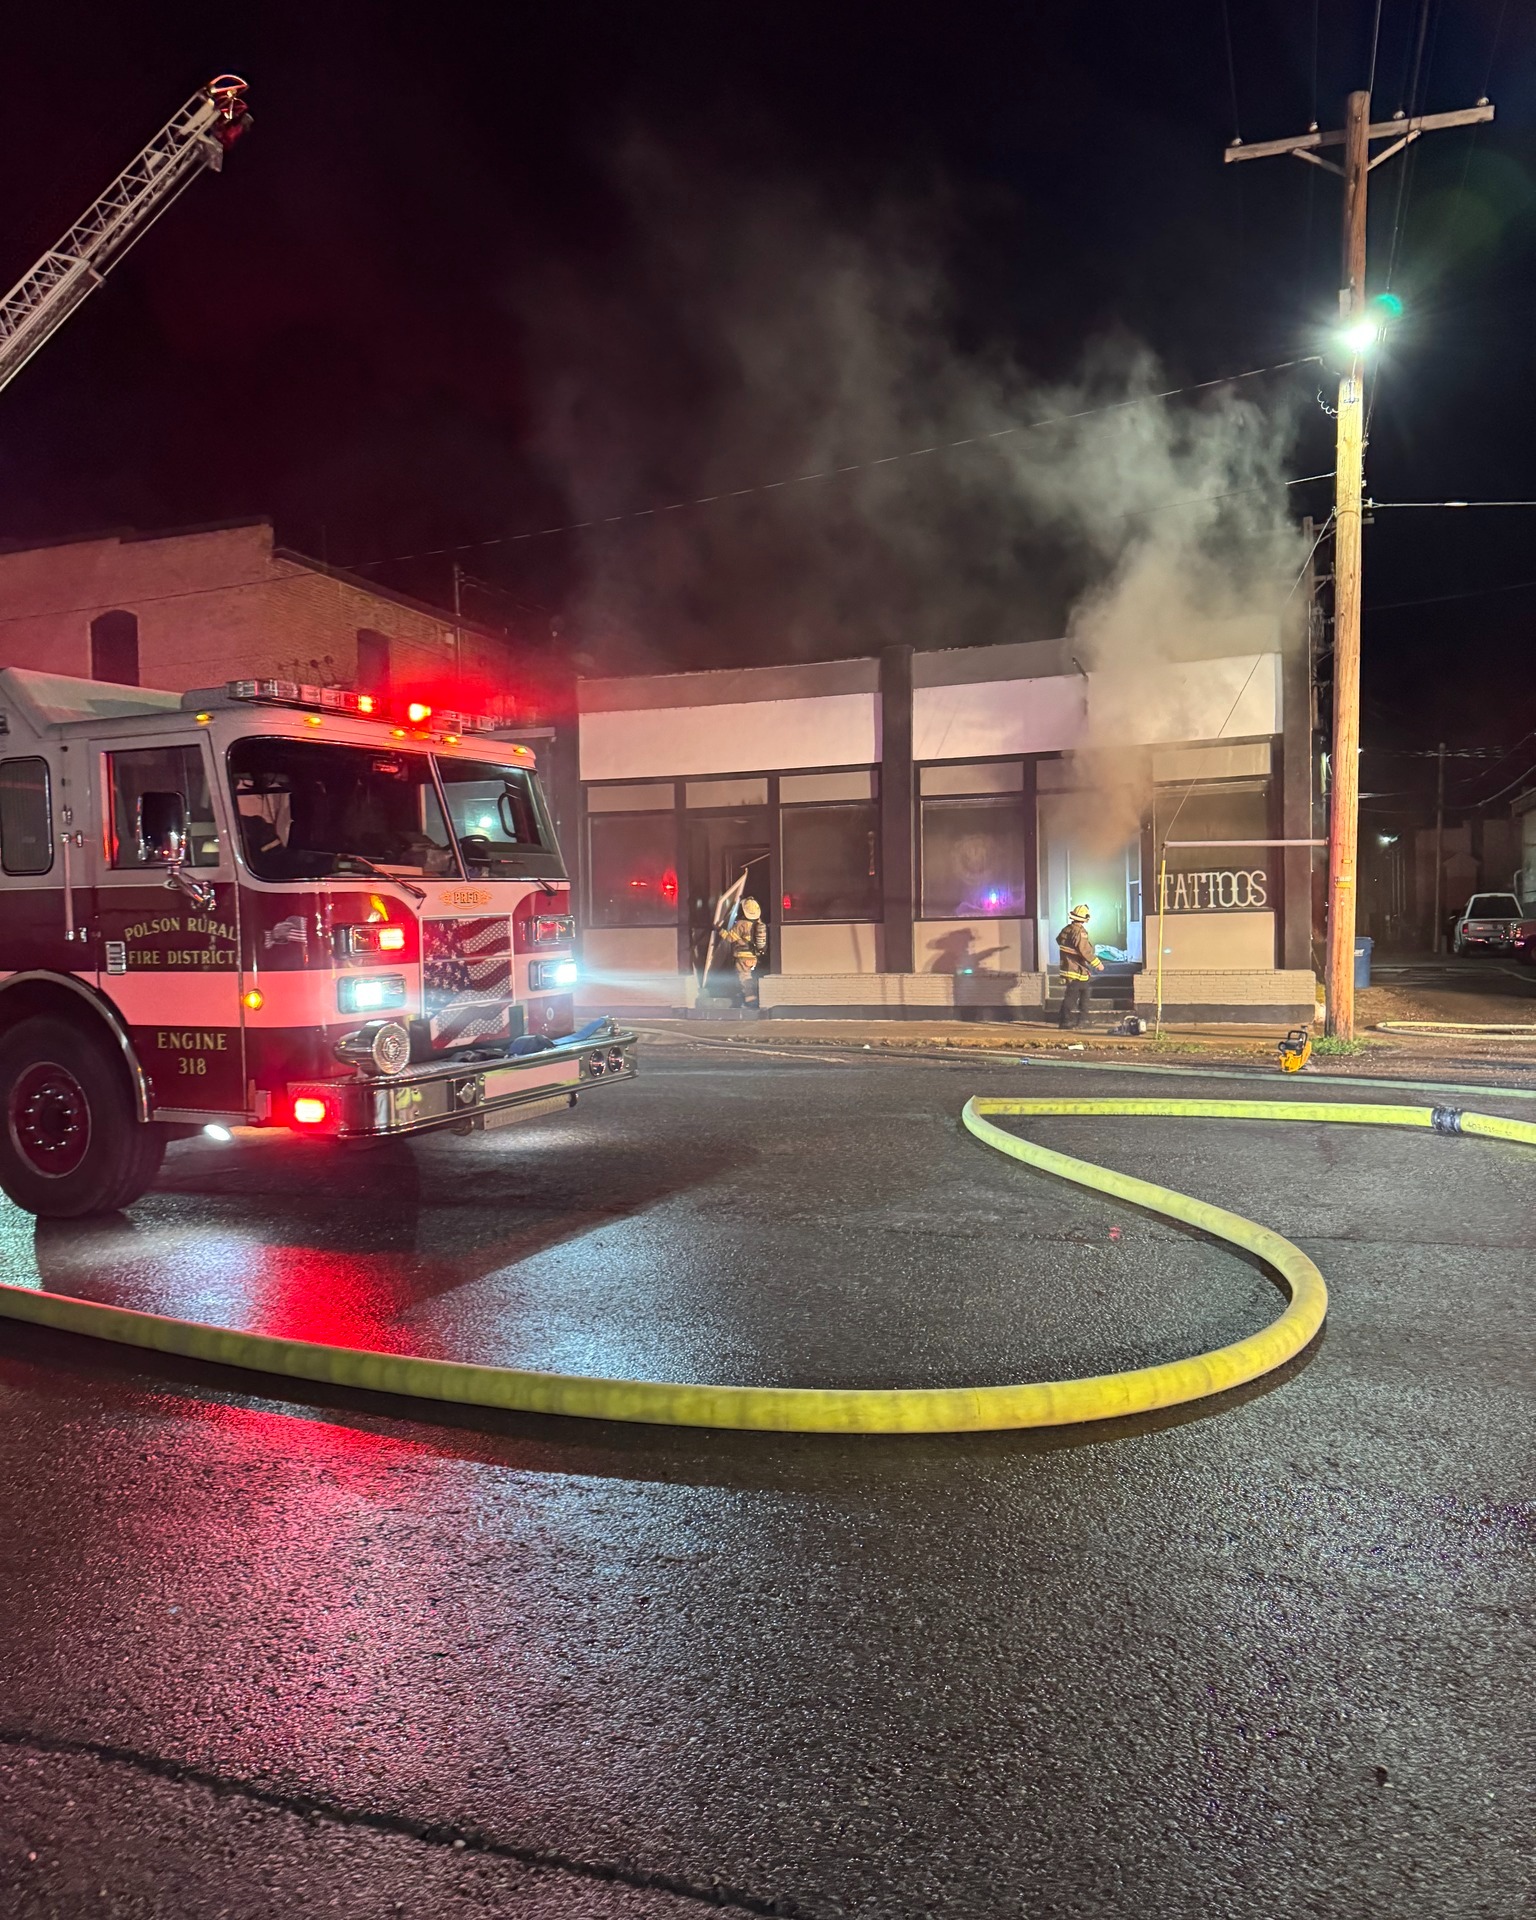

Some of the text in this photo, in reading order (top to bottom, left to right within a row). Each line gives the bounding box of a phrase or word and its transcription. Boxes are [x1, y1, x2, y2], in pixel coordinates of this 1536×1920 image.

[1157, 869, 1267, 909] TATTOOS
[124, 917, 237, 941] POLSON RURAL
[128, 950, 236, 964] FIRE DISTRICT
[157, 1032, 227, 1050] ENGINE
[178, 1057, 207, 1075] 318
